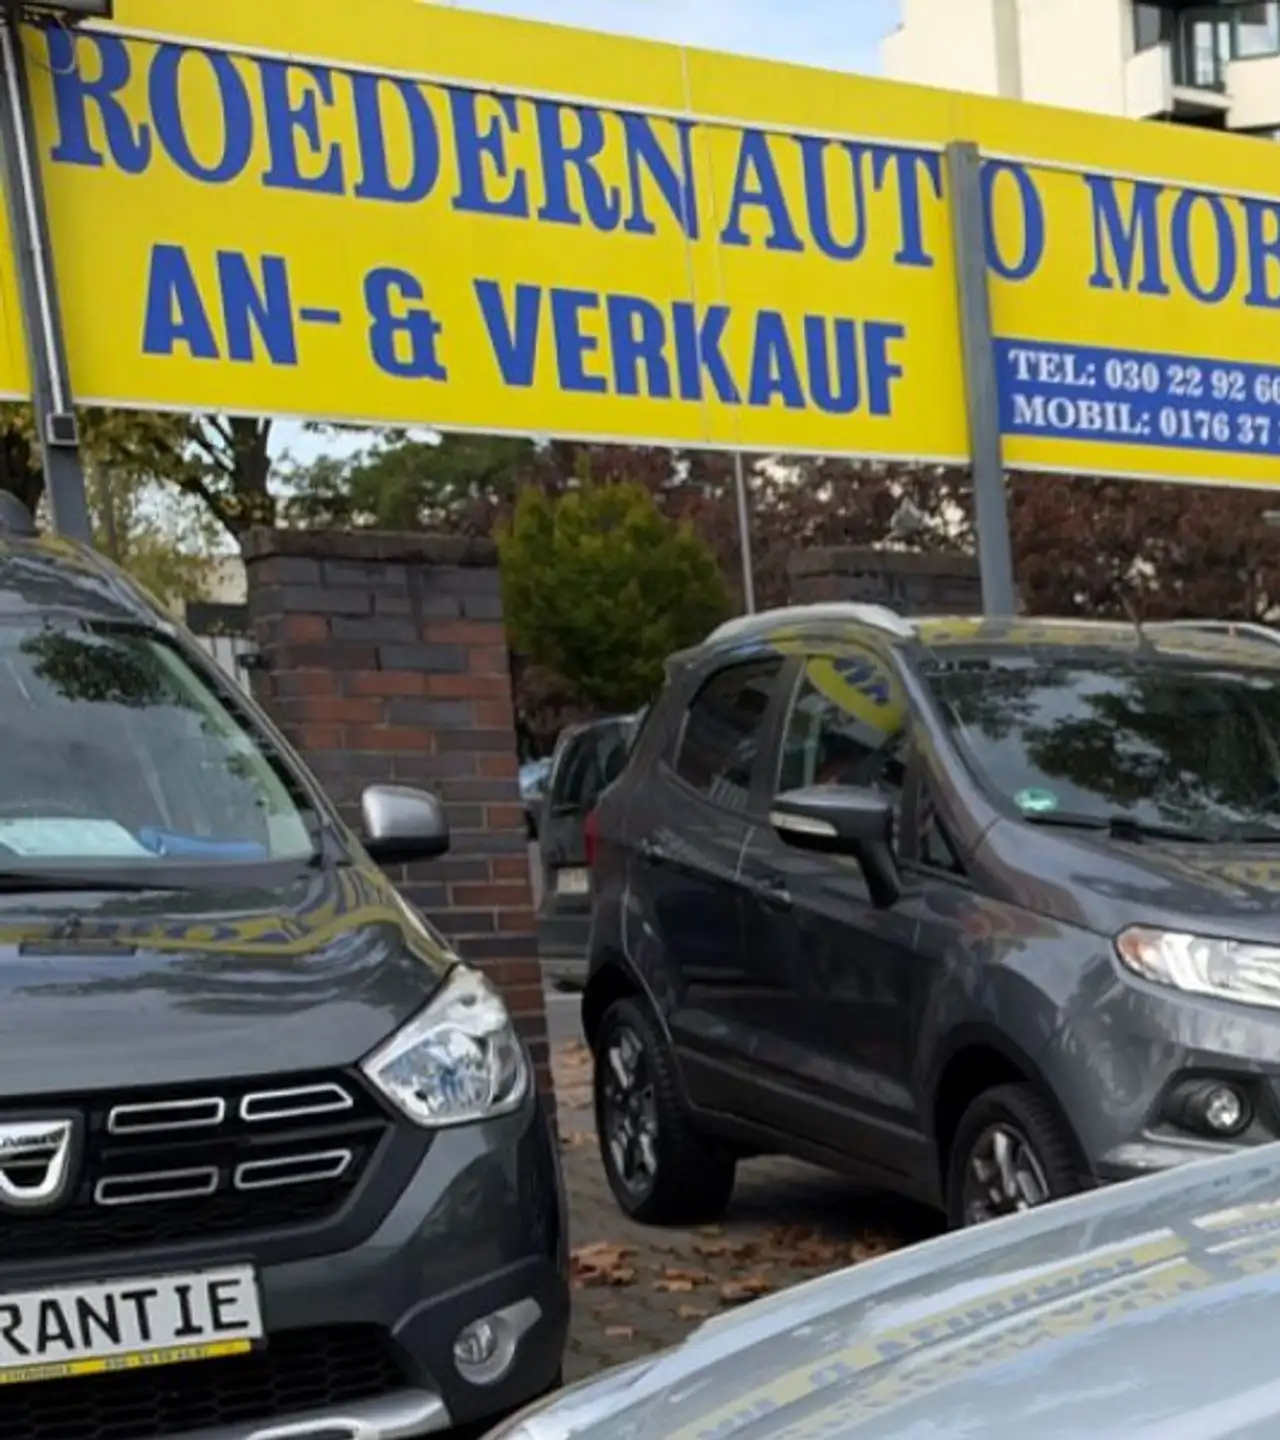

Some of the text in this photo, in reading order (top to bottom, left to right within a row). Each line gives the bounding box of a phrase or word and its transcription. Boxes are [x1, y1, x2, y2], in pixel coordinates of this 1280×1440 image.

[47, 22, 698, 240] ROEDERN
[141, 244, 906, 416] AN- & VERKAUF
[1008, 349, 1096, 388] TEL:
[1104, 358, 1159, 394] 030
[1167, 365, 1203, 398] 22
[1211, 370, 1246, 401] 92
[1011, 394, 1151, 437] MOBIL:
[1159, 405, 1231, 442] 0176
[1237, 413, 1273, 445] 37
